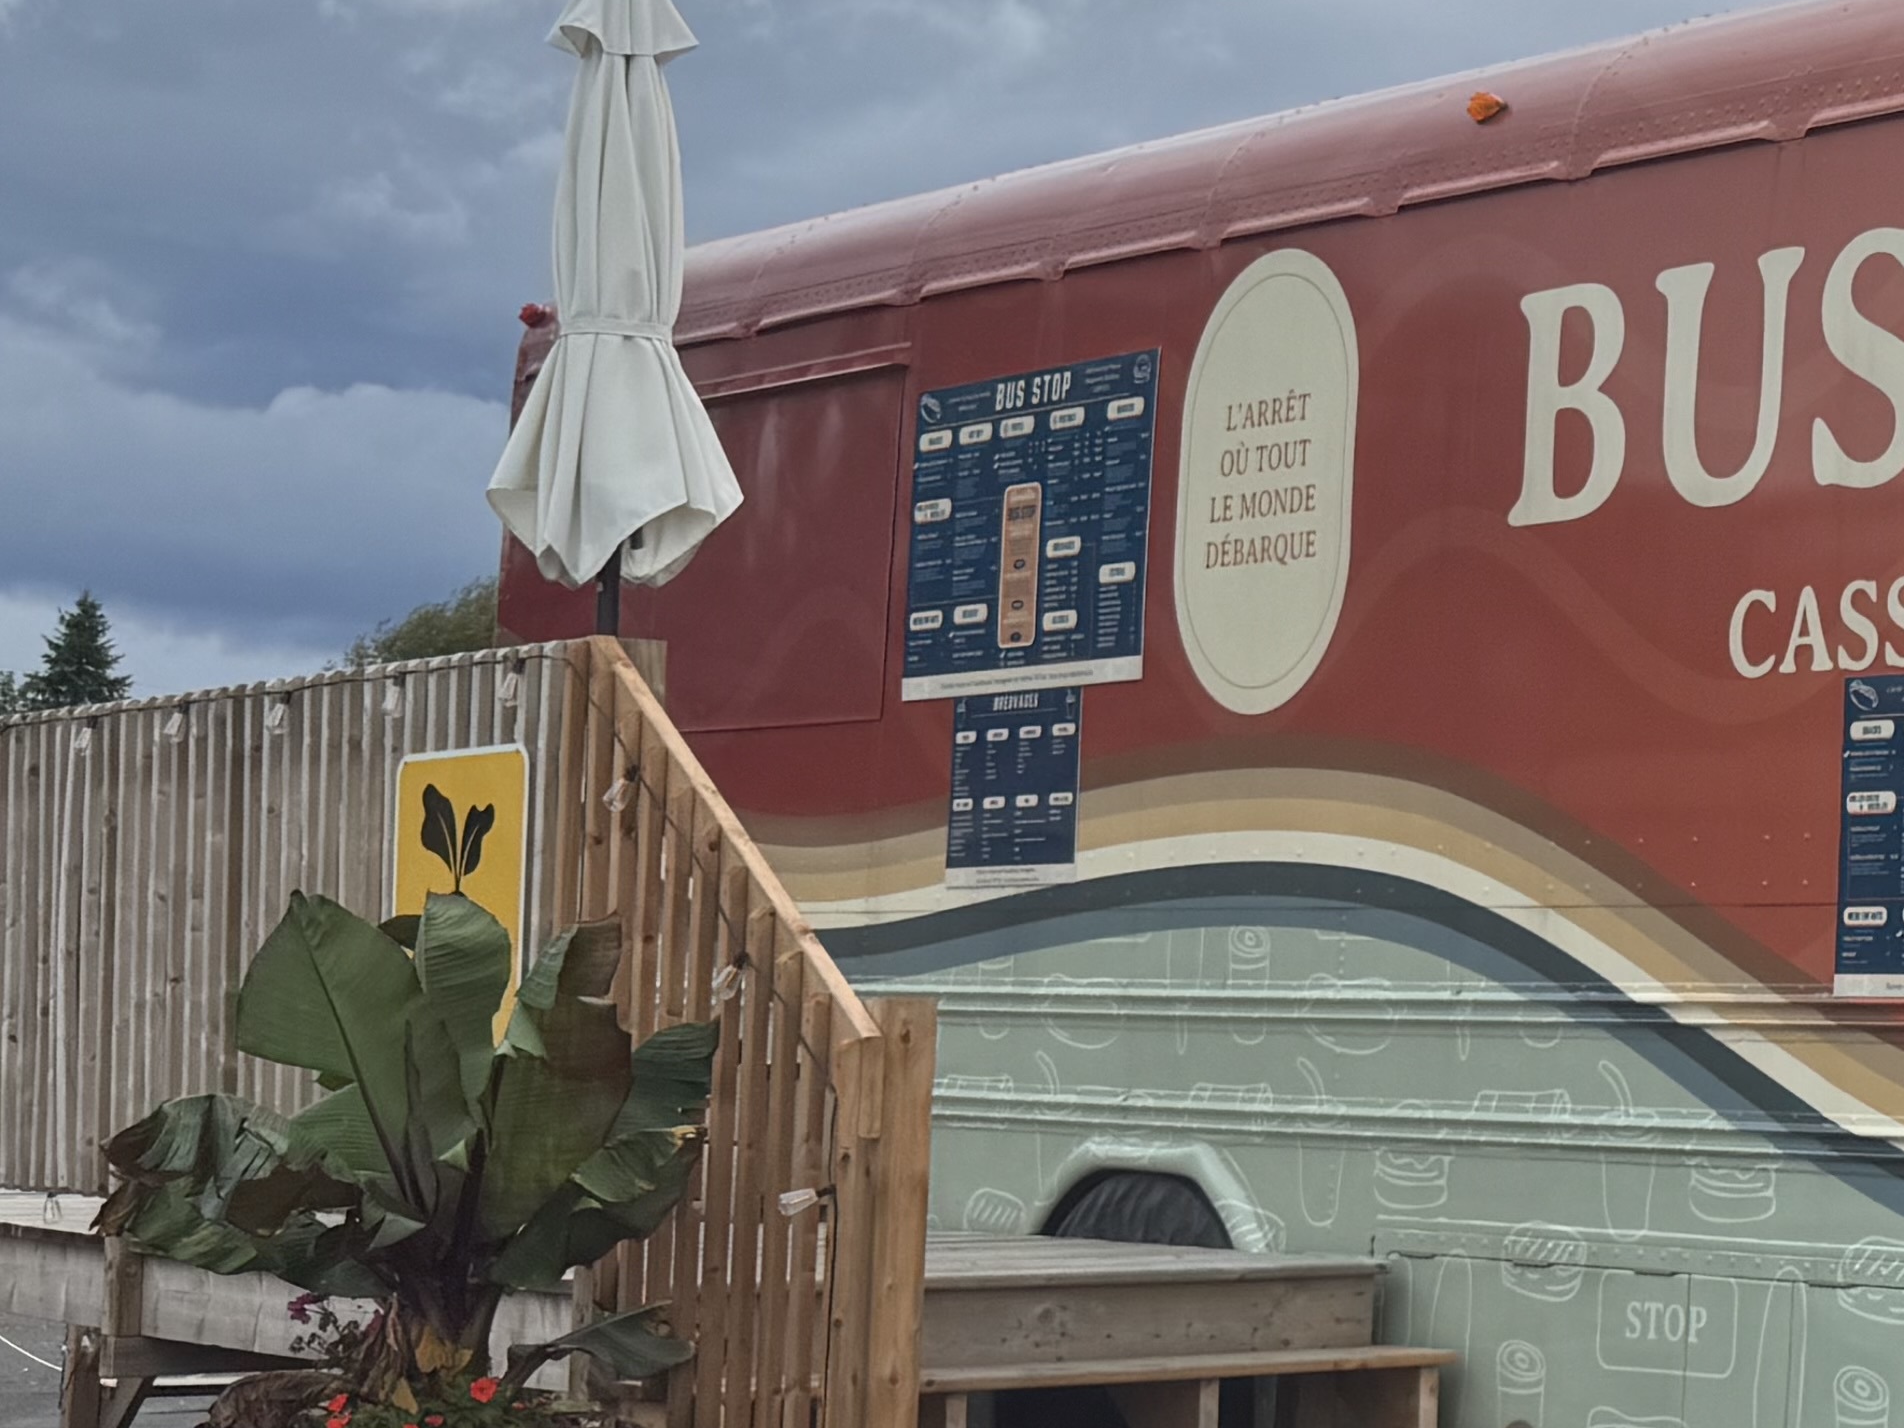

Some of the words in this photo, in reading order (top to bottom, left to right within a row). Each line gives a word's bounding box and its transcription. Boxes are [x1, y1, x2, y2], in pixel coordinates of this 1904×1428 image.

[994, 381, 1026, 412] BUS
[1031, 370, 1071, 406] STOP
[1225, 388, 1312, 432] L'ARRÊT
[1220, 441, 1249, 477] OÙ
[1256, 438, 1312, 473] TOUT
[1209, 494, 1233, 523] LE
[1239, 484, 1317, 521] MONDE
[1205, 529, 1317, 570] DÉBARQUE
[1625, 1301, 1708, 1344] STOP
